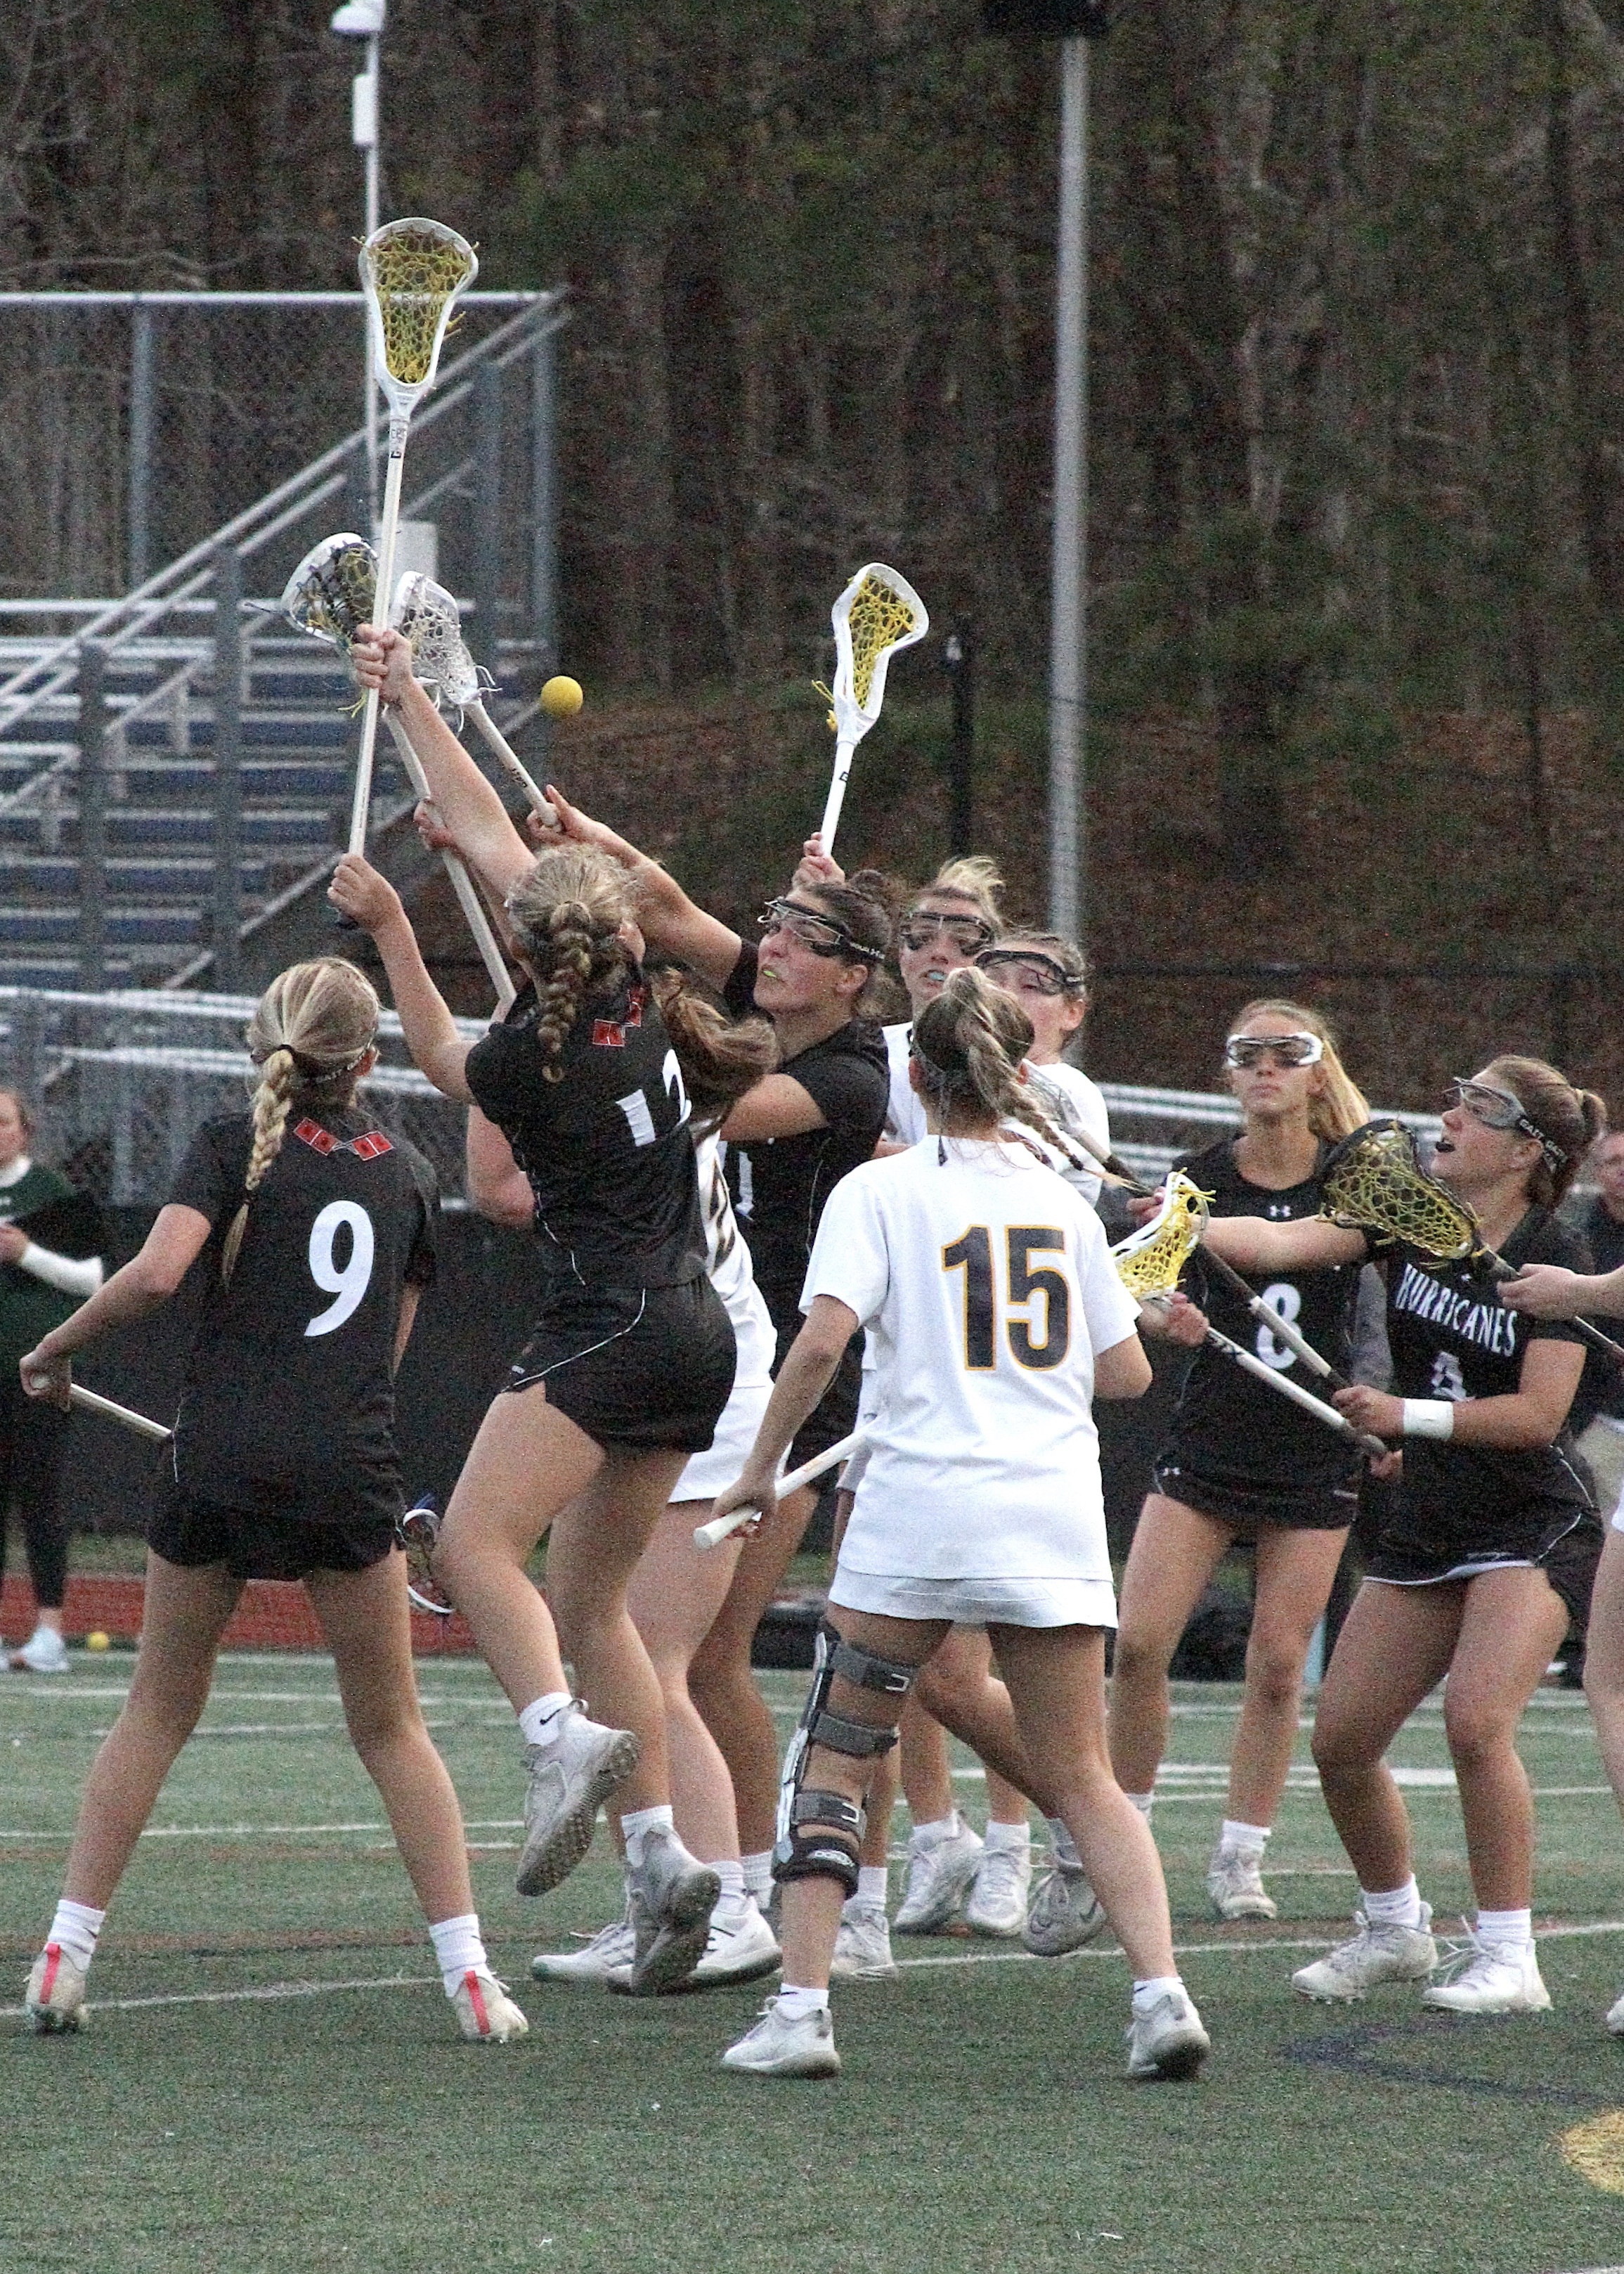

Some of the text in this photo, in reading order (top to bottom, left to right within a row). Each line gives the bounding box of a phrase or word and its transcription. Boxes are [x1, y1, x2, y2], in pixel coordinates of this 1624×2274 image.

[304, 1200, 375, 1336] 9
[940, 1223, 1072, 1371] 15
[1395, 1262, 1518, 1357] HURRICANES
[1256, 1283, 1304, 1370] 8
